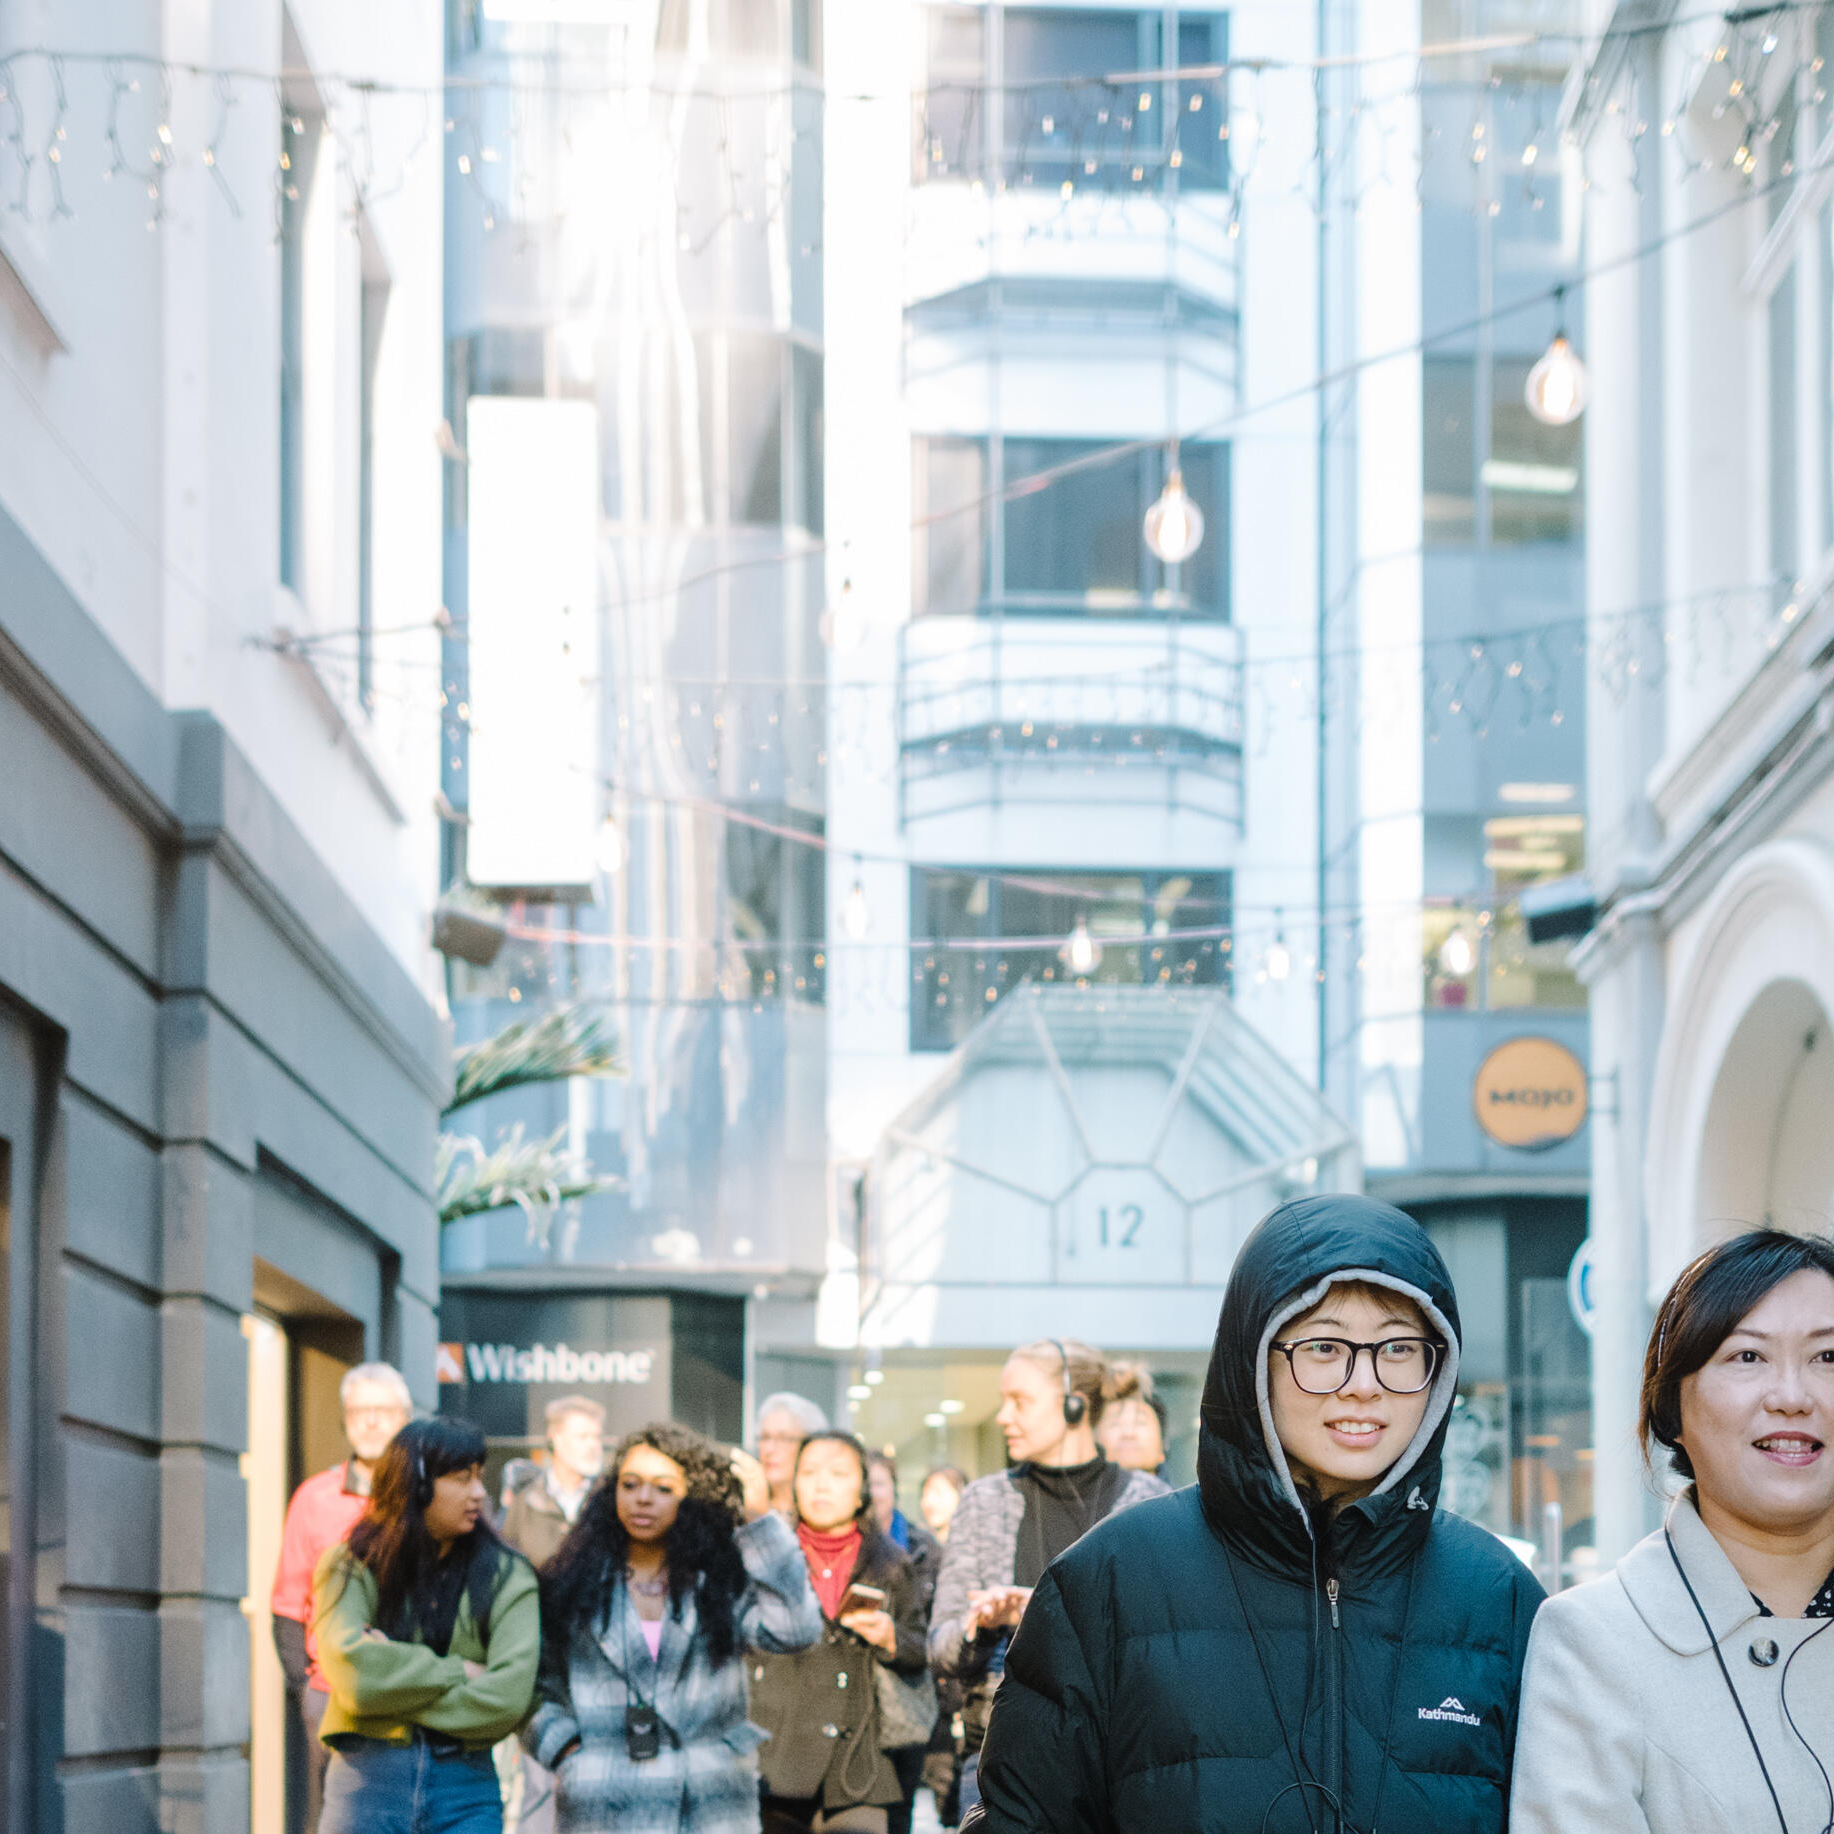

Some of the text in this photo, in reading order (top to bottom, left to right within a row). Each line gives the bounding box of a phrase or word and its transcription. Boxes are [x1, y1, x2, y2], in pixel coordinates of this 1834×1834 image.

[1097, 1205, 1145, 1248] 12
[467, 1342, 652, 1383] Wishbone
[1418, 1707, 1480, 1727] Kathmandu
